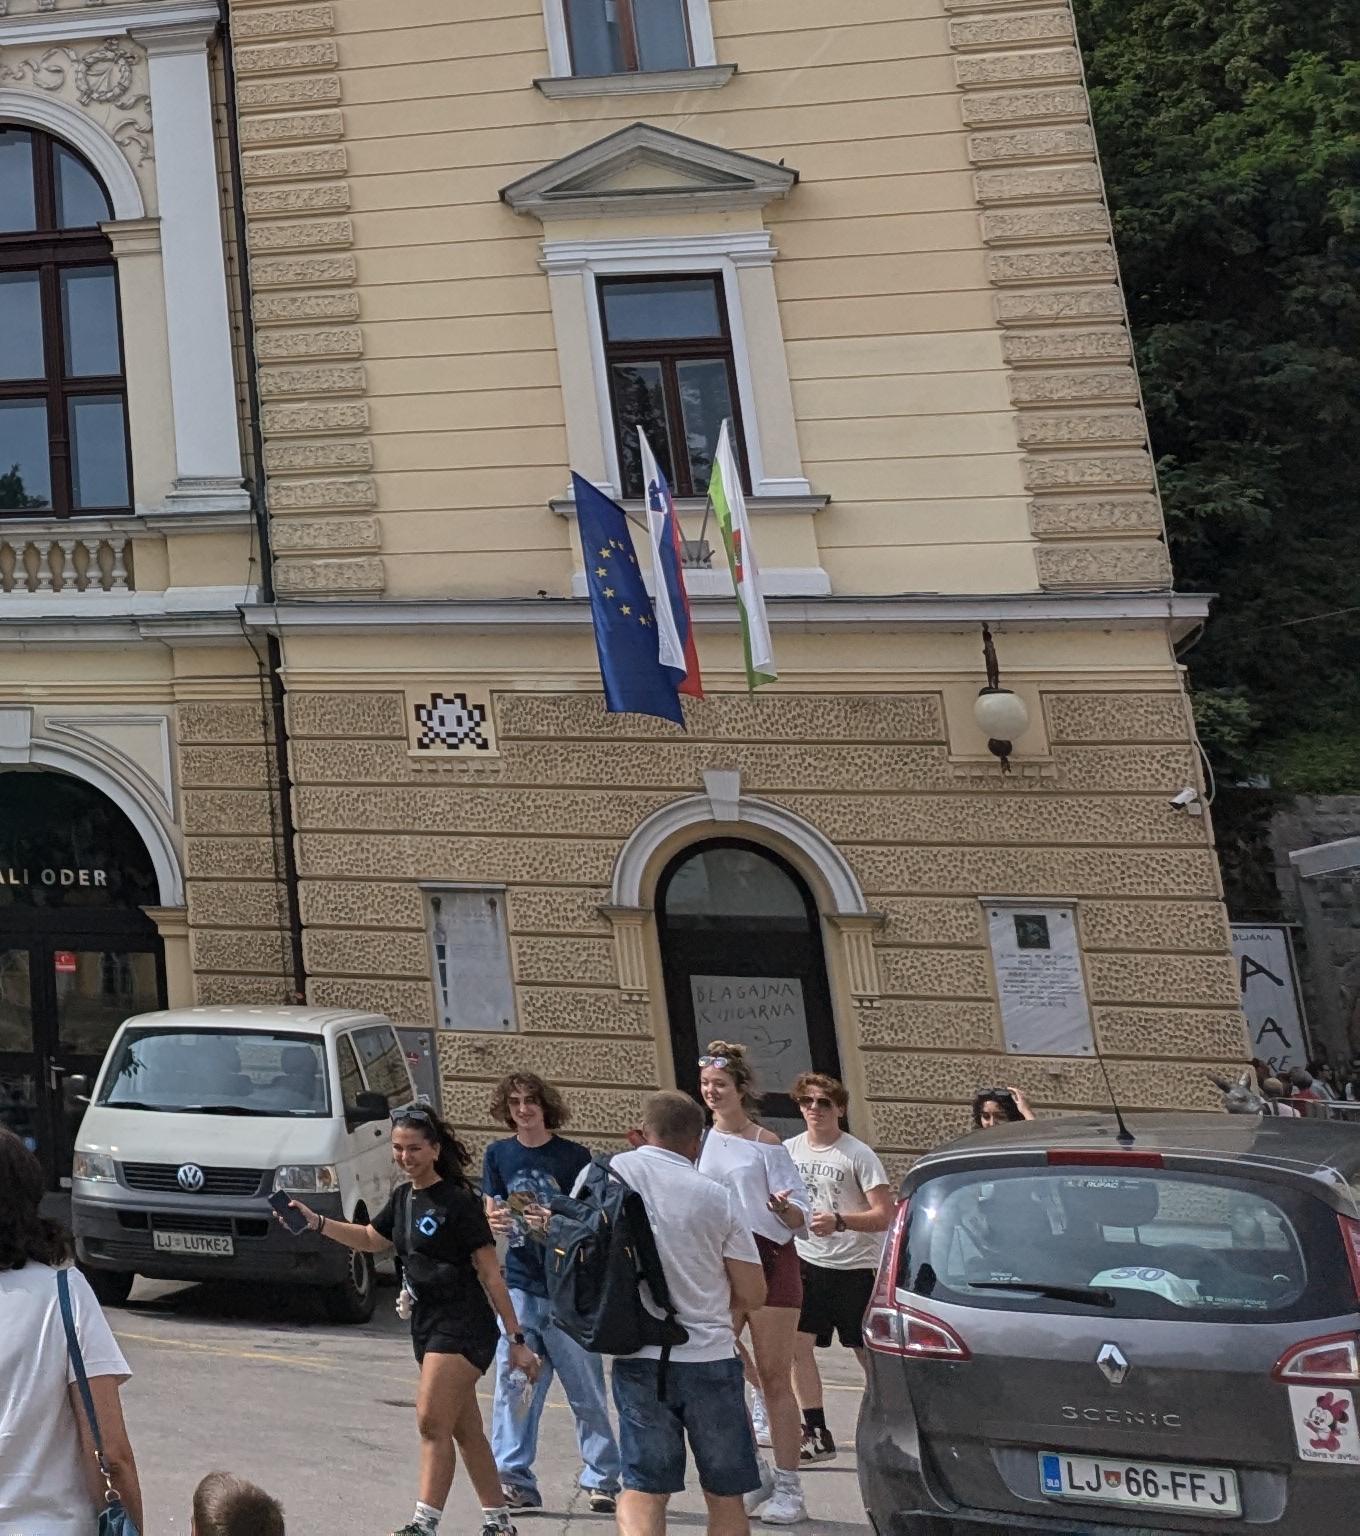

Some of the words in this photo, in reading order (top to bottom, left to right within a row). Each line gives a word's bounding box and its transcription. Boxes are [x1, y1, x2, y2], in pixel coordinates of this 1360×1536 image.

[41, 868, 107, 886] ODER
[1232, 933, 1273, 942] BLJANA
[811, 1163, 845, 1182] FLOYD
[157, 1233, 172, 1248] LJ
[183, 1236, 231, 1252] LUTKE2
[1061, 1405, 1182, 1427] SCENIC
[1066, 1461, 1102, 1493] LJ
[1125, 1466, 1228, 1506] 66-FFJ
